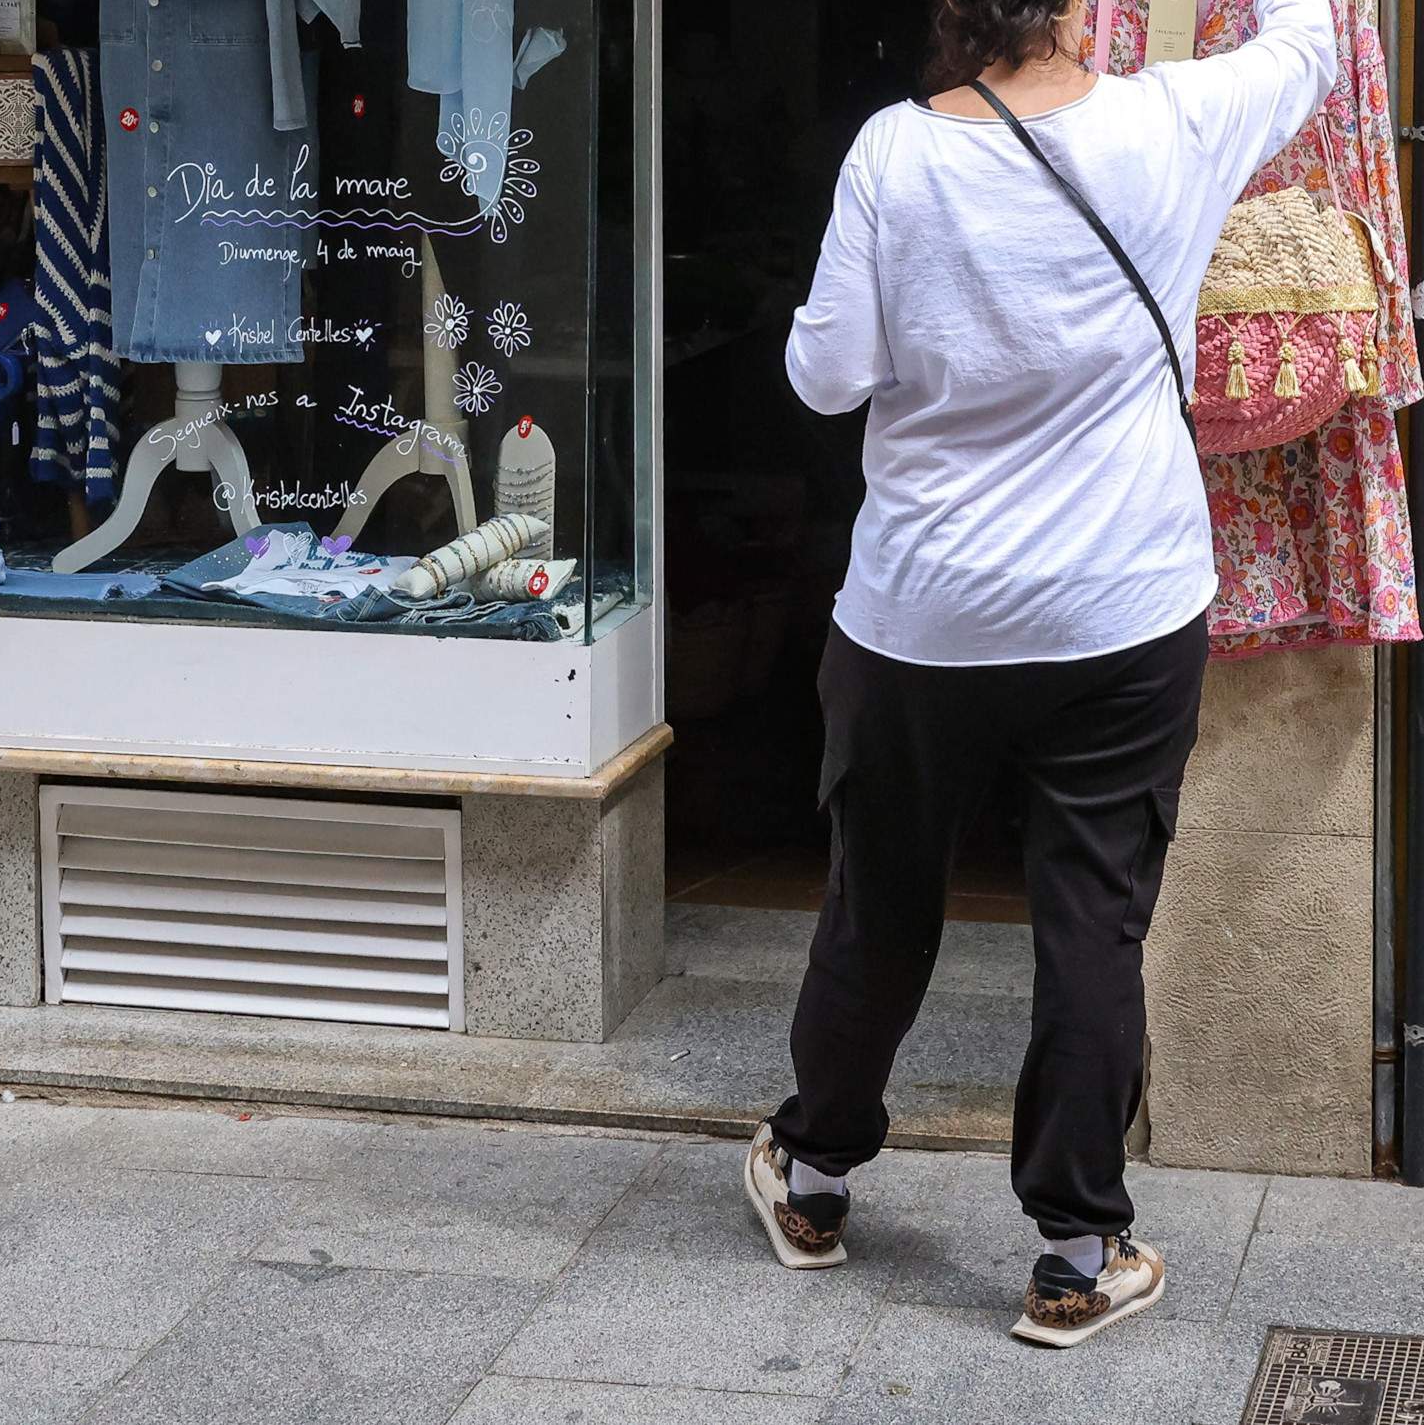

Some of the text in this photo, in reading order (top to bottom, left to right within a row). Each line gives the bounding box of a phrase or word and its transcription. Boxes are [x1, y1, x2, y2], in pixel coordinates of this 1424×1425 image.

[245, 164, 277, 199] de
[289, 144, 318, 200] la
[335, 175, 412, 200] mare
[317, 239, 329, 264] 4
[337, 239, 358, 260] de
[366, 245, 422, 279] maig
[296, 393, 318, 409] a
[338, 383, 469, 459] Instagram
[533, 576, 546, 591] 5€
